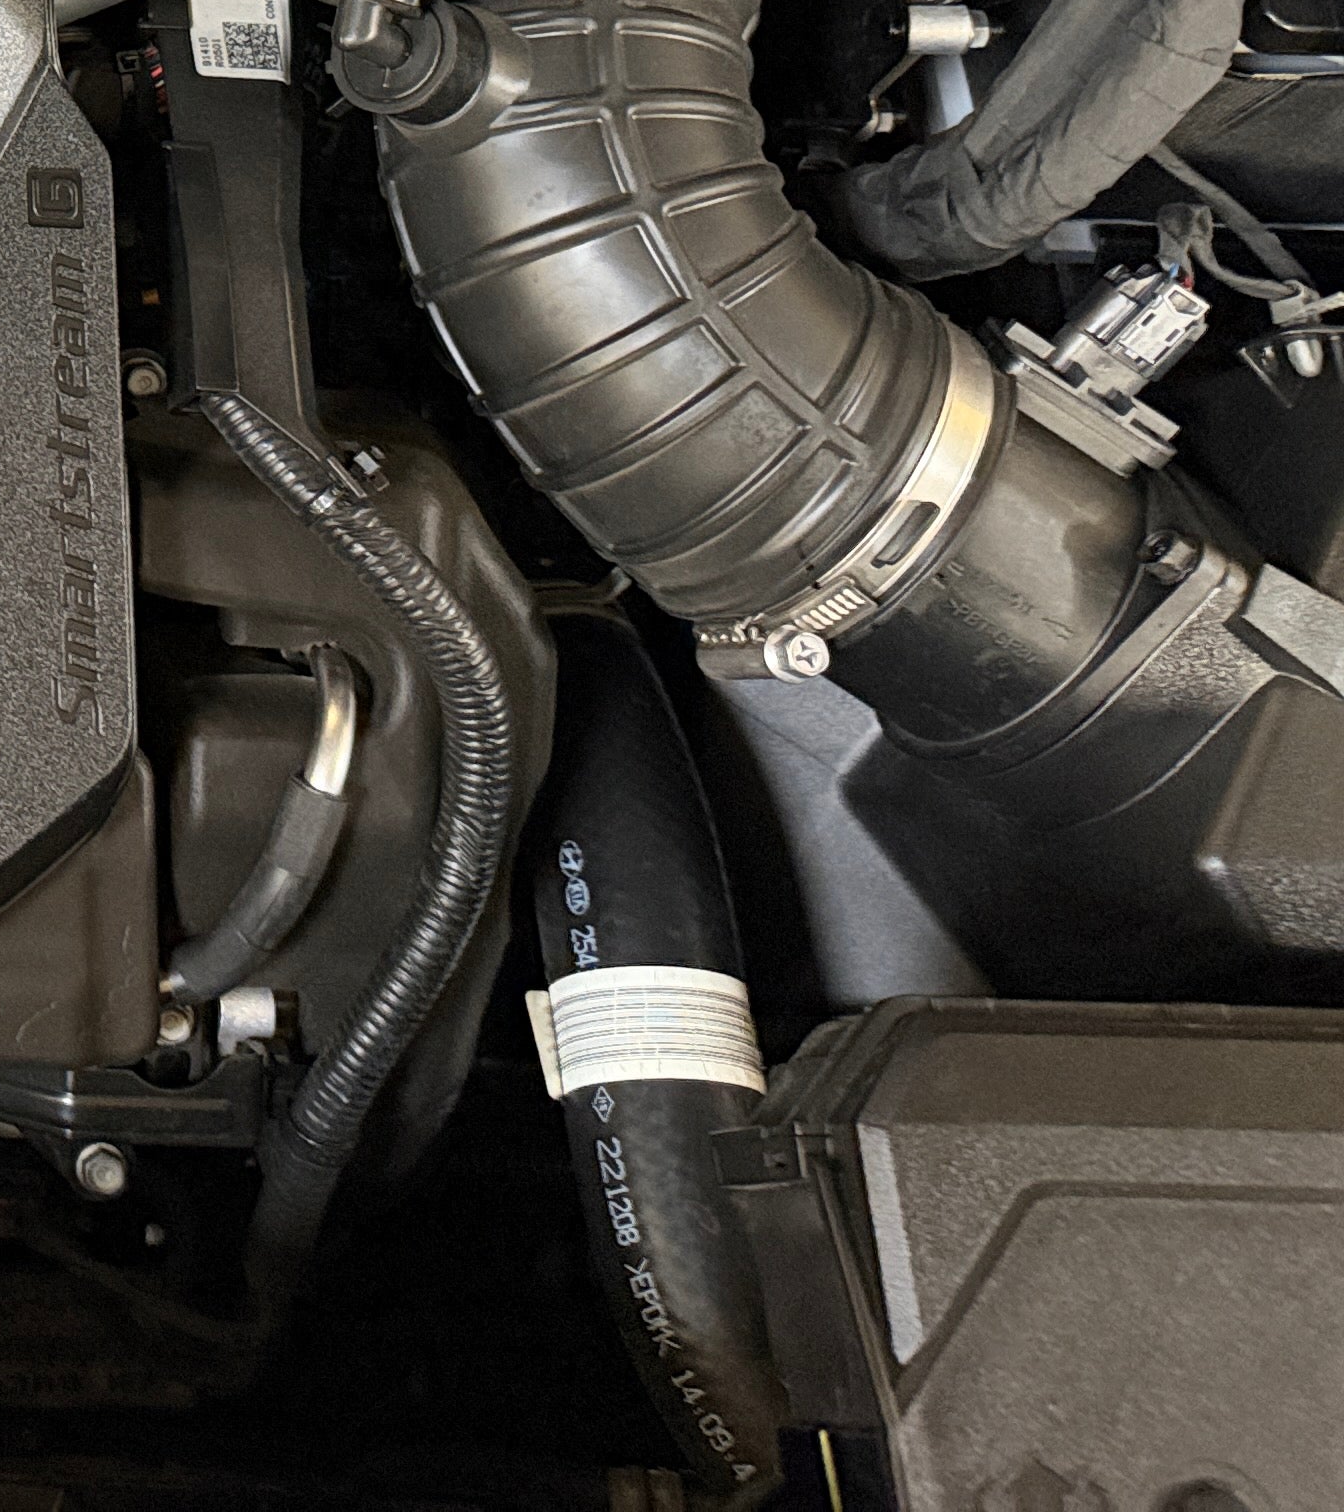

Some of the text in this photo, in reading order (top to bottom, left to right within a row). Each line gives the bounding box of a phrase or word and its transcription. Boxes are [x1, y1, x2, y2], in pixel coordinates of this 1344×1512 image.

[46, 252, 107, 737] Smartstream
[570, 924, 601, 972] 254
[596, 1136, 641, 1247] 221208
